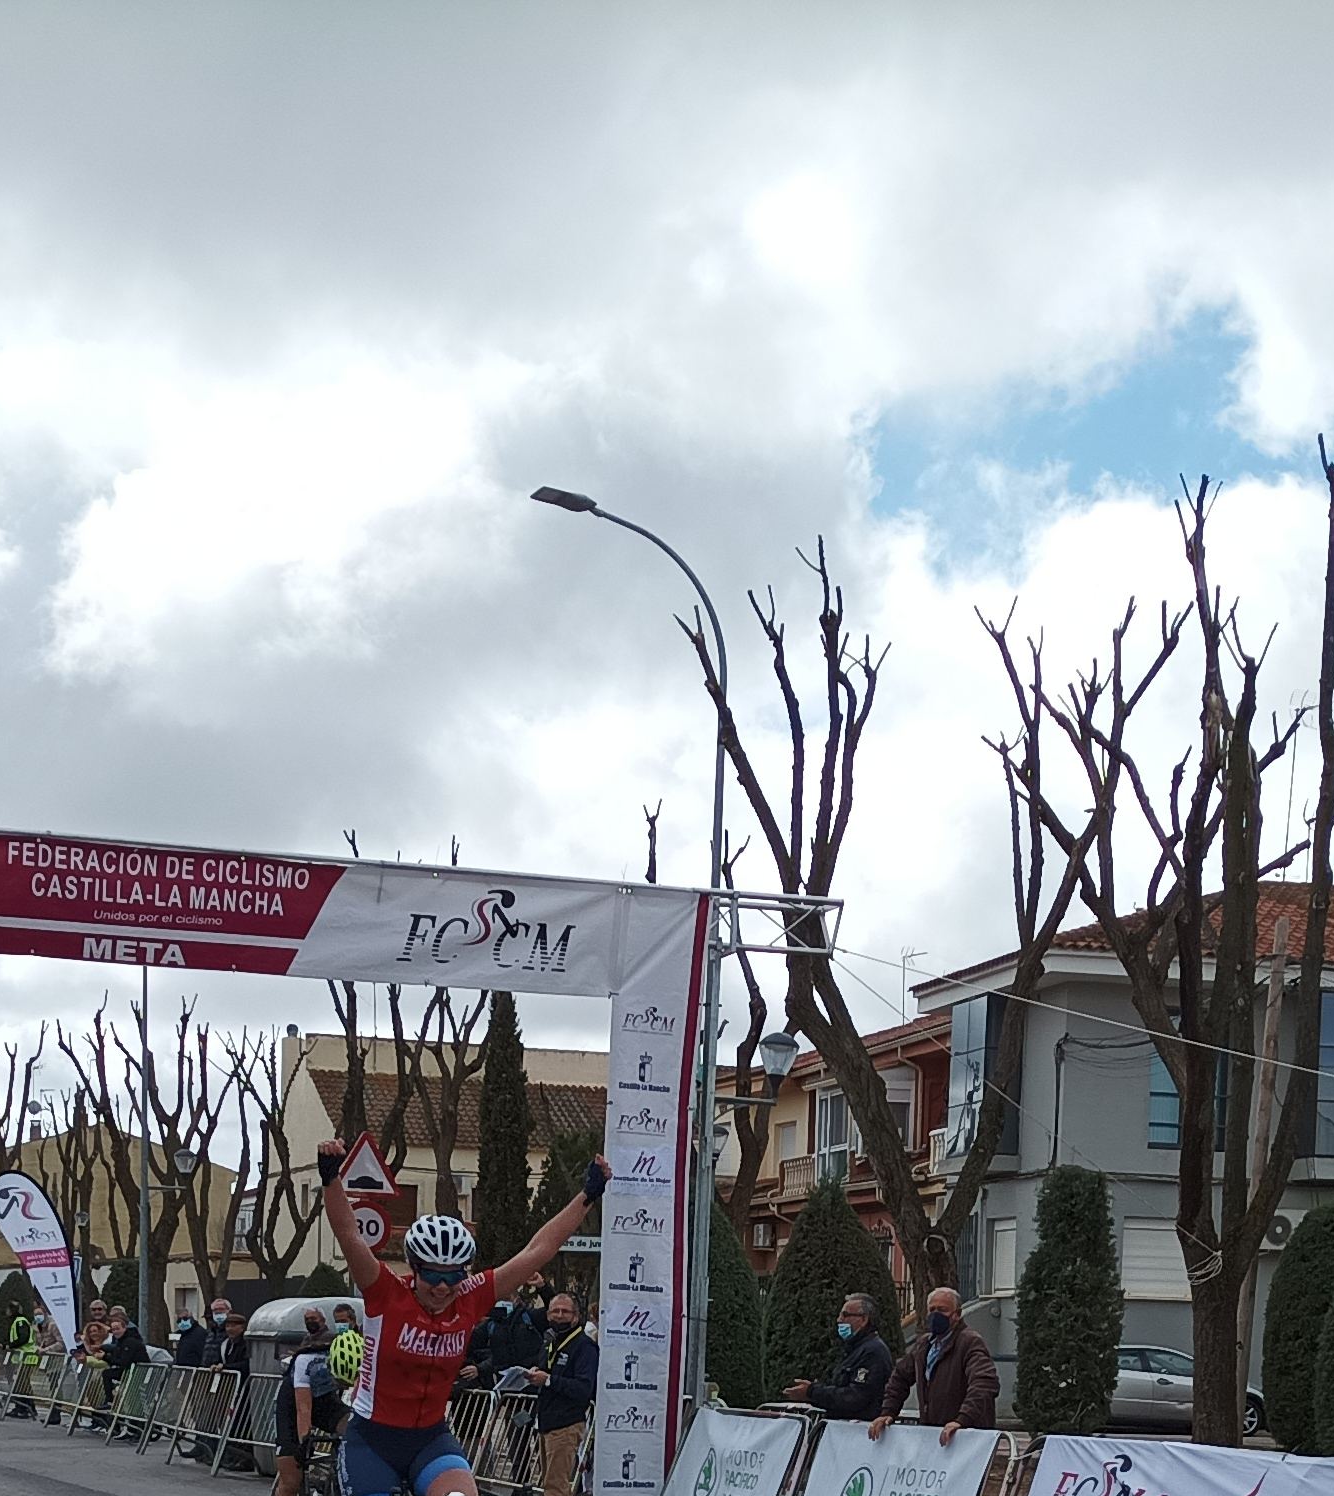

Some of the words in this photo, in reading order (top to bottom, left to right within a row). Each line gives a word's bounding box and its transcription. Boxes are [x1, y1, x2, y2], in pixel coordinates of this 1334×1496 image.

[7, 841, 158, 877] FEDERACIÓN
[165, 856, 194, 880] DE
[202, 858, 310, 890] CICLISMO
[31, 873, 183, 908] CASTILLA-LA
[189, 885, 284, 917] MANCHA
[93, 909, 135, 921] Unidos
[138, 914, 158, 924] por
[162, 914, 173, 923] el
[175, 915, 223, 926] ciclismo
[82, 937, 186, 966] META
[360, 1336, 376, 1393] MADRID
[894, 1467, 947, 1488] MOTOR
